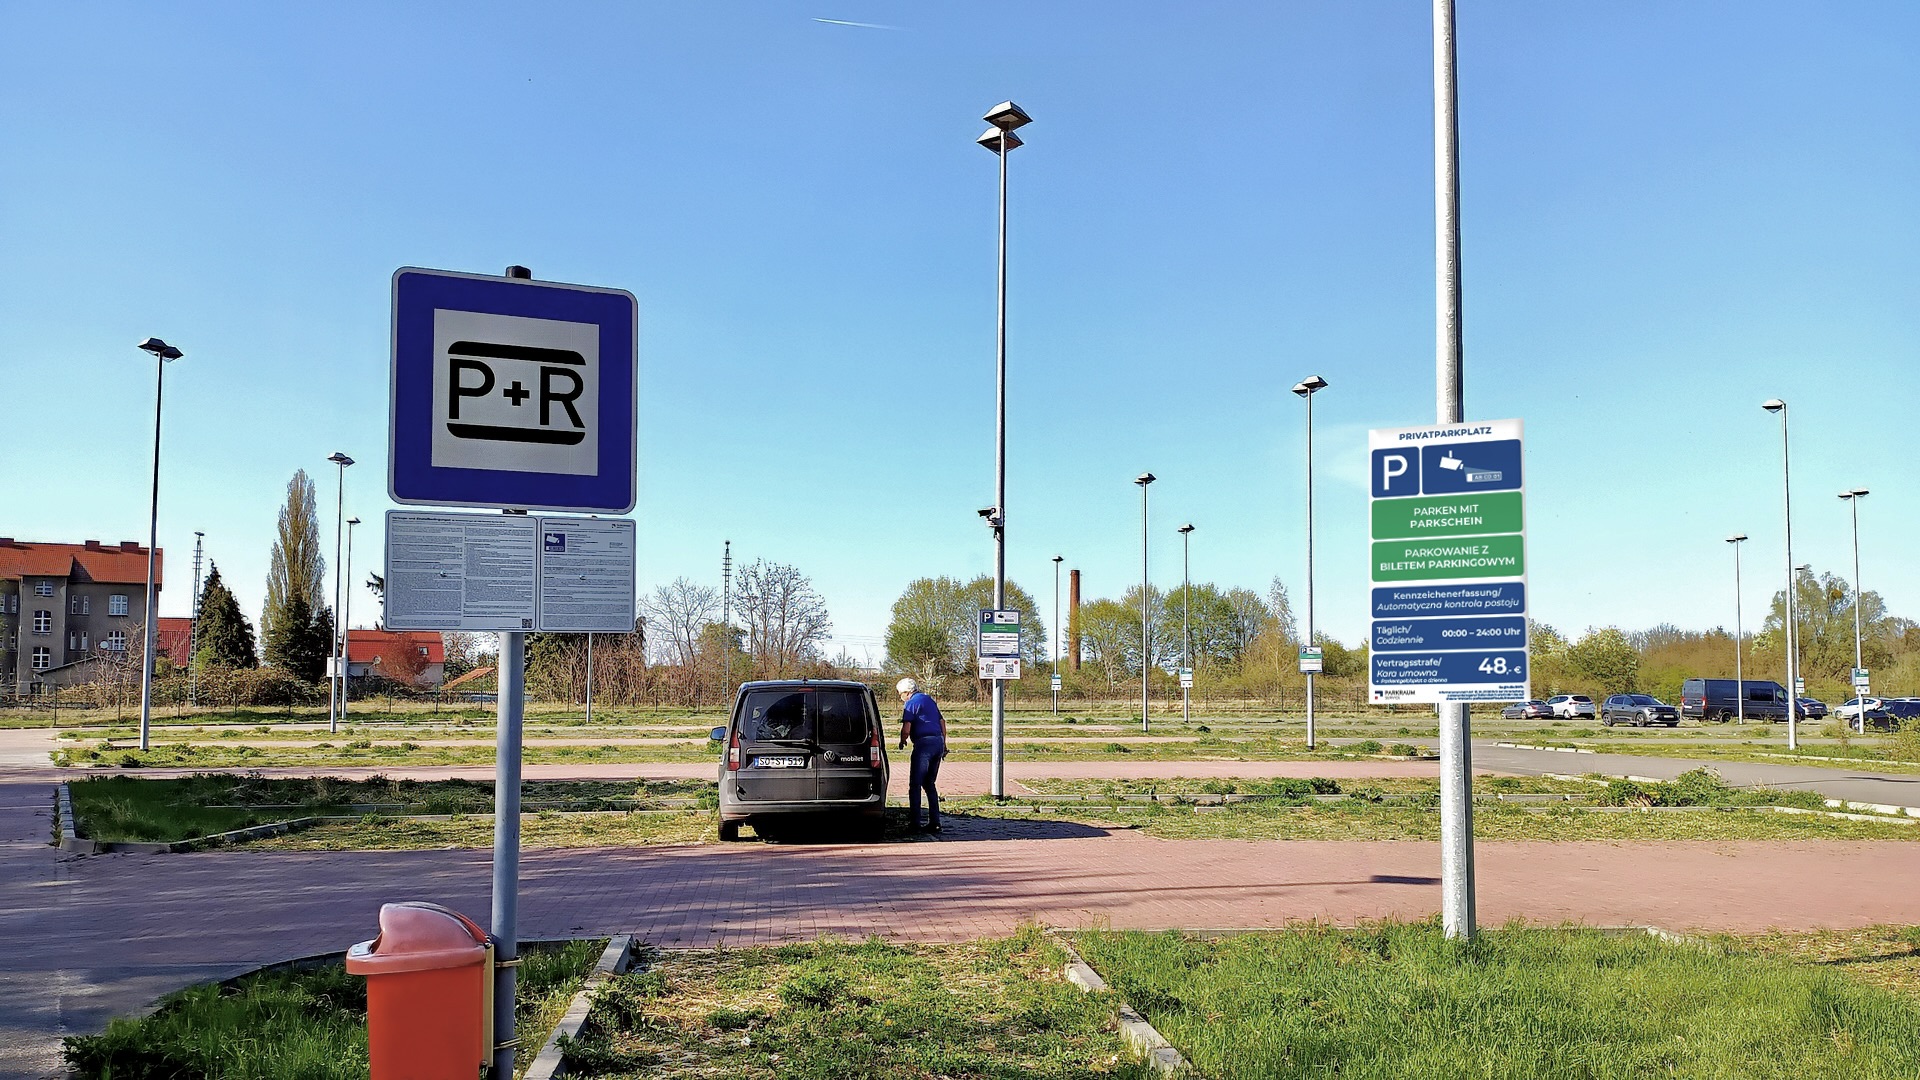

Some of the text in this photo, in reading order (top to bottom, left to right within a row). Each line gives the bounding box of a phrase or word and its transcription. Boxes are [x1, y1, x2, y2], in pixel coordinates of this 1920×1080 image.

[449, 358, 585, 428] P+R
[1399, 427, 1492, 440] PRIVATPARKPLATZ
[1383, 455, 1408, 491] P
[1413, 504, 1479, 517] PARKEN MIT
[1410, 516, 1483, 528] PARKSCHEIN
[1405, 545, 1489, 558] PARKOWANIE Z
[1380, 557, 1515, 571] BILETEM PARKINGOWYM
[1393, 588, 1502, 600] Kennzeichenerfassung/
[1376, 598, 1520, 611] Automatyczna kontrola postoju
[1376, 625, 1412, 636] Täglich/
[1441, 629, 1468, 637] 00:00
[1476, 628, 1502, 637] 24:00
[1503, 628, 1521, 636] Uhr
[1376, 635, 1424, 645] Codziennie
[1376, 657, 1442, 669] Vertragsstrafe/
[1399, 669, 1438, 677] umowna
